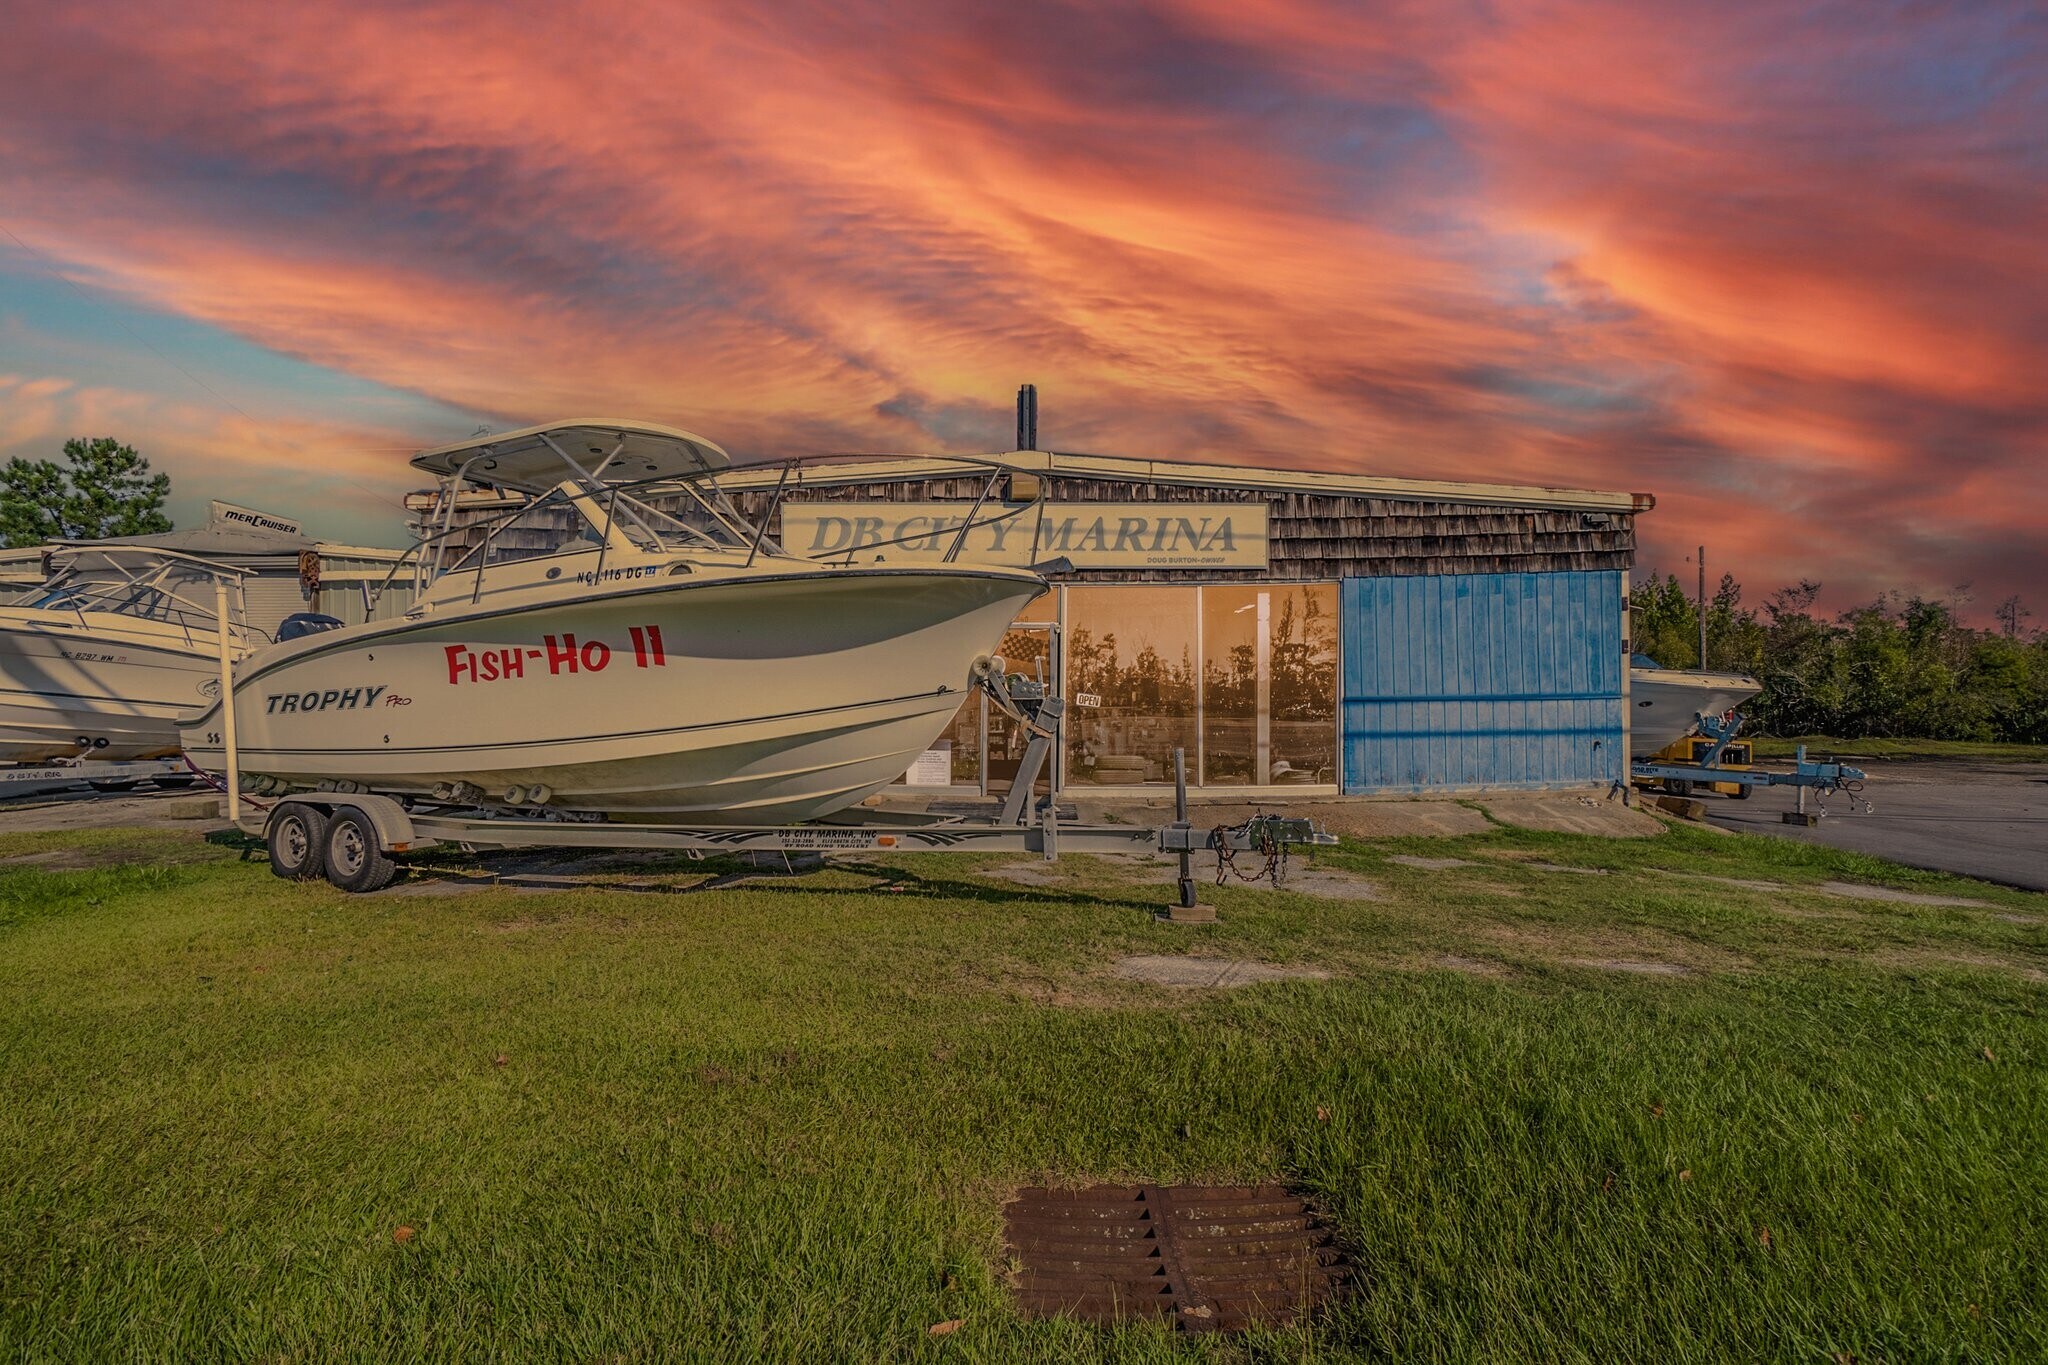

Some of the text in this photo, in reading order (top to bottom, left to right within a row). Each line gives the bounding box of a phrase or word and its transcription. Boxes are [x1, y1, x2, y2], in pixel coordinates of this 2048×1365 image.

[225, 510, 297, 534] MERCRUISER
[808, 516, 1238, 552] DB CITY MARINA
[577, 567, 642, 583] NC 116 DG
[444, 633, 611, 685] FISH-HO
[266, 685, 413, 716] TROPHY PRO
[1078, 694, 1100, 706] OPEN
[778, 830, 877, 839] DB CITY MARINA, INC
